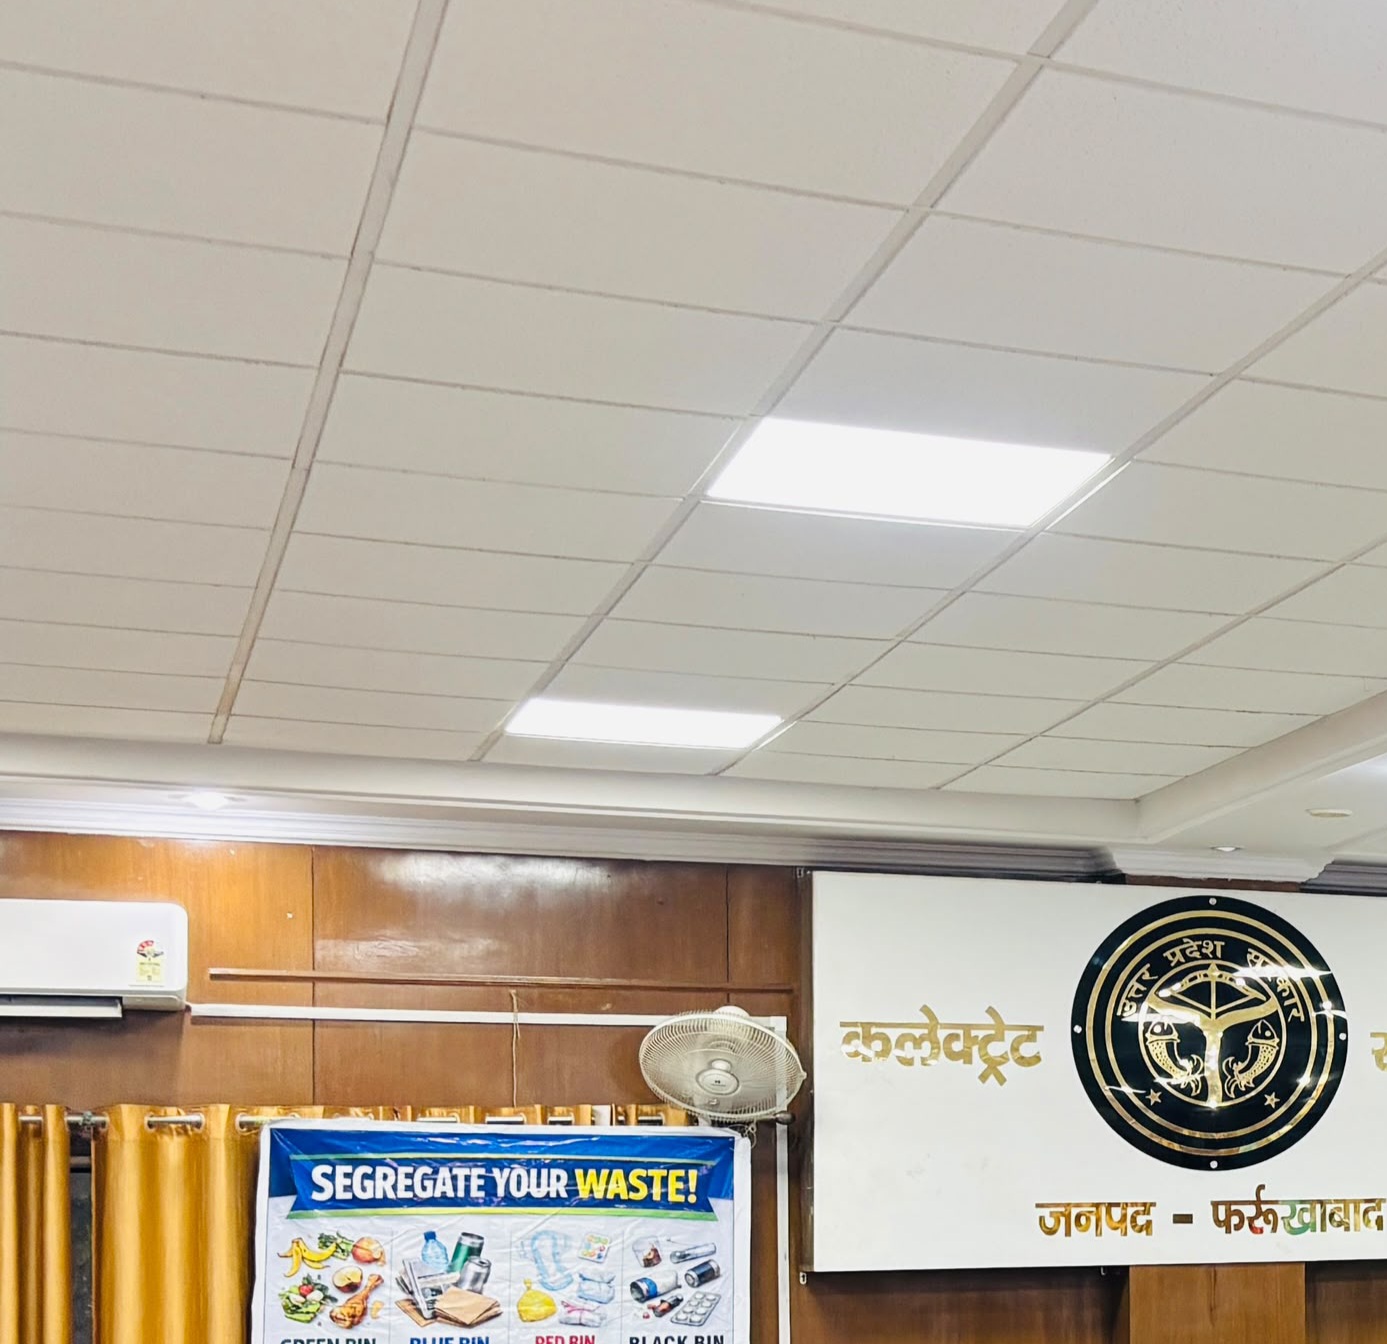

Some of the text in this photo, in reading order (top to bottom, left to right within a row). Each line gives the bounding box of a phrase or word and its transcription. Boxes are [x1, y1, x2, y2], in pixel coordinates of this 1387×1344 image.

[1116, 938, 1305, 1022] उत्तर प्रदेश सकार
[840, 1005, 1044, 1086] कलेक्ट्रेट
[311, 1164, 698, 1204] SEGREGATE YOUR WASTE!
[1036, 1201, 1156, 1237] जनपद
